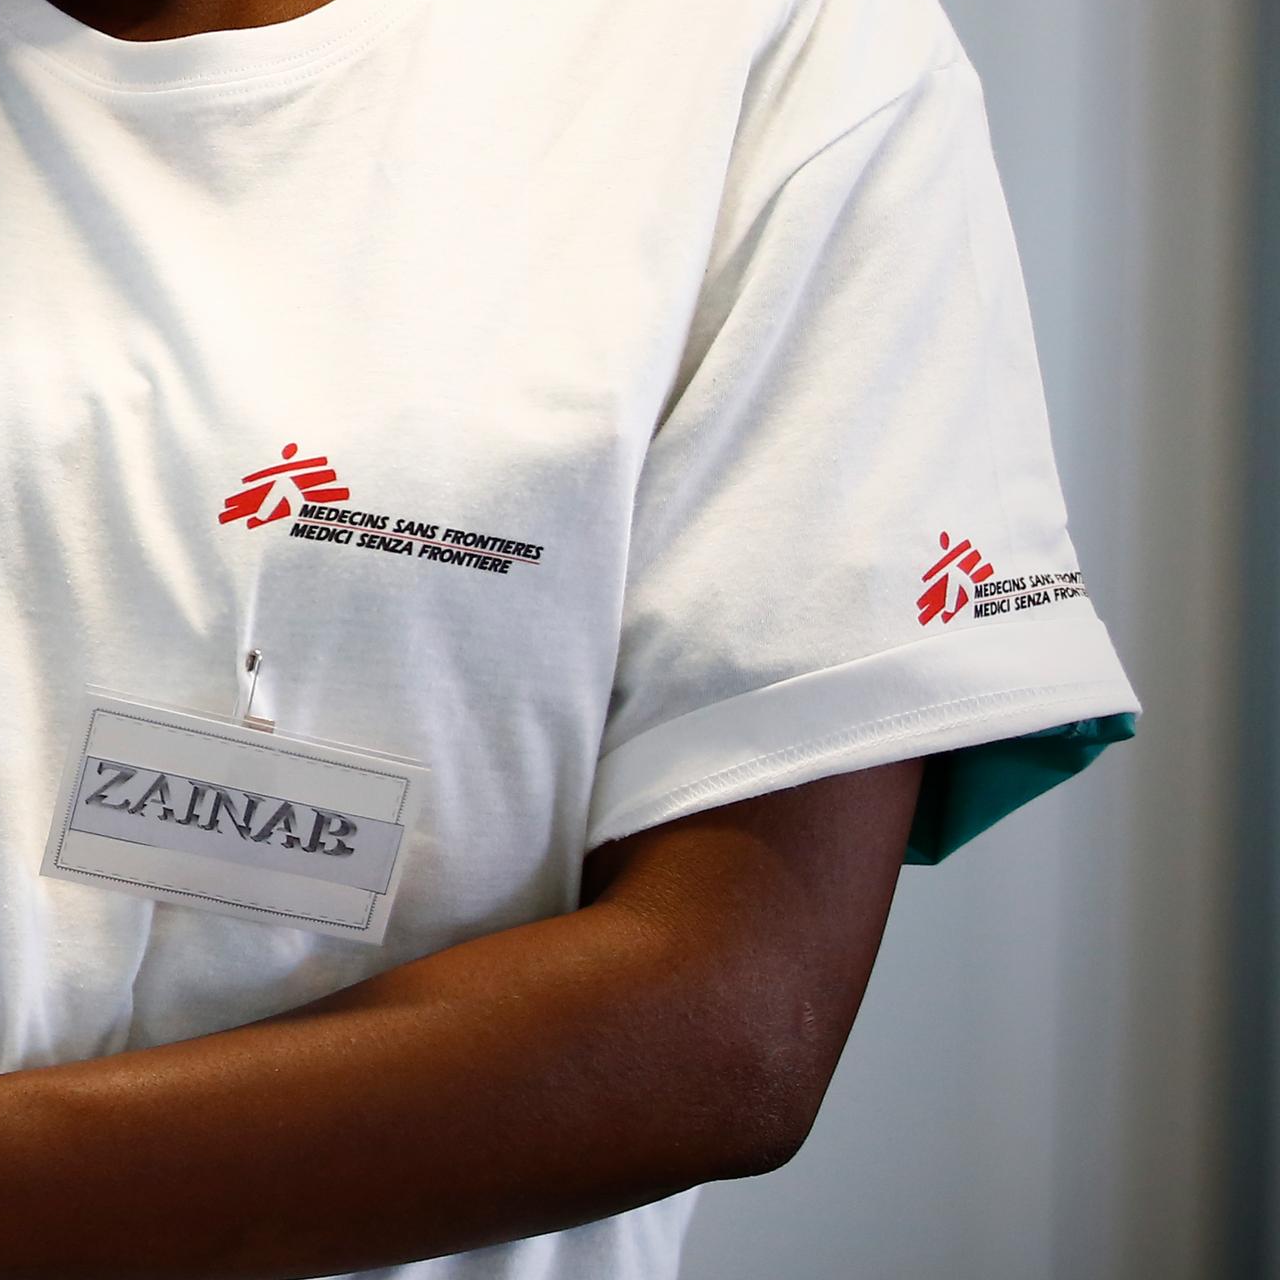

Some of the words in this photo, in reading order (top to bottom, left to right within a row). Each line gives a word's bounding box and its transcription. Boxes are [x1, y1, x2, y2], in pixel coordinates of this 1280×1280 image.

[290, 523, 353, 545] MEDICI
[357, 533, 413, 556] SENZA
[418, 545, 512, 574] FRONTIERE
[298, 504, 390, 531] MEDECINS
[392, 518, 441, 540] SANS
[441, 529, 544, 561] FRONTIERES
[974, 577, 1027, 599] MEDECINS
[1029, 574, 1054, 588] SANS
[974, 598, 1011, 619] MEDICI
[1014, 591, 1051, 610] SENZA
[85, 761, 358, 856] ZAINAB
